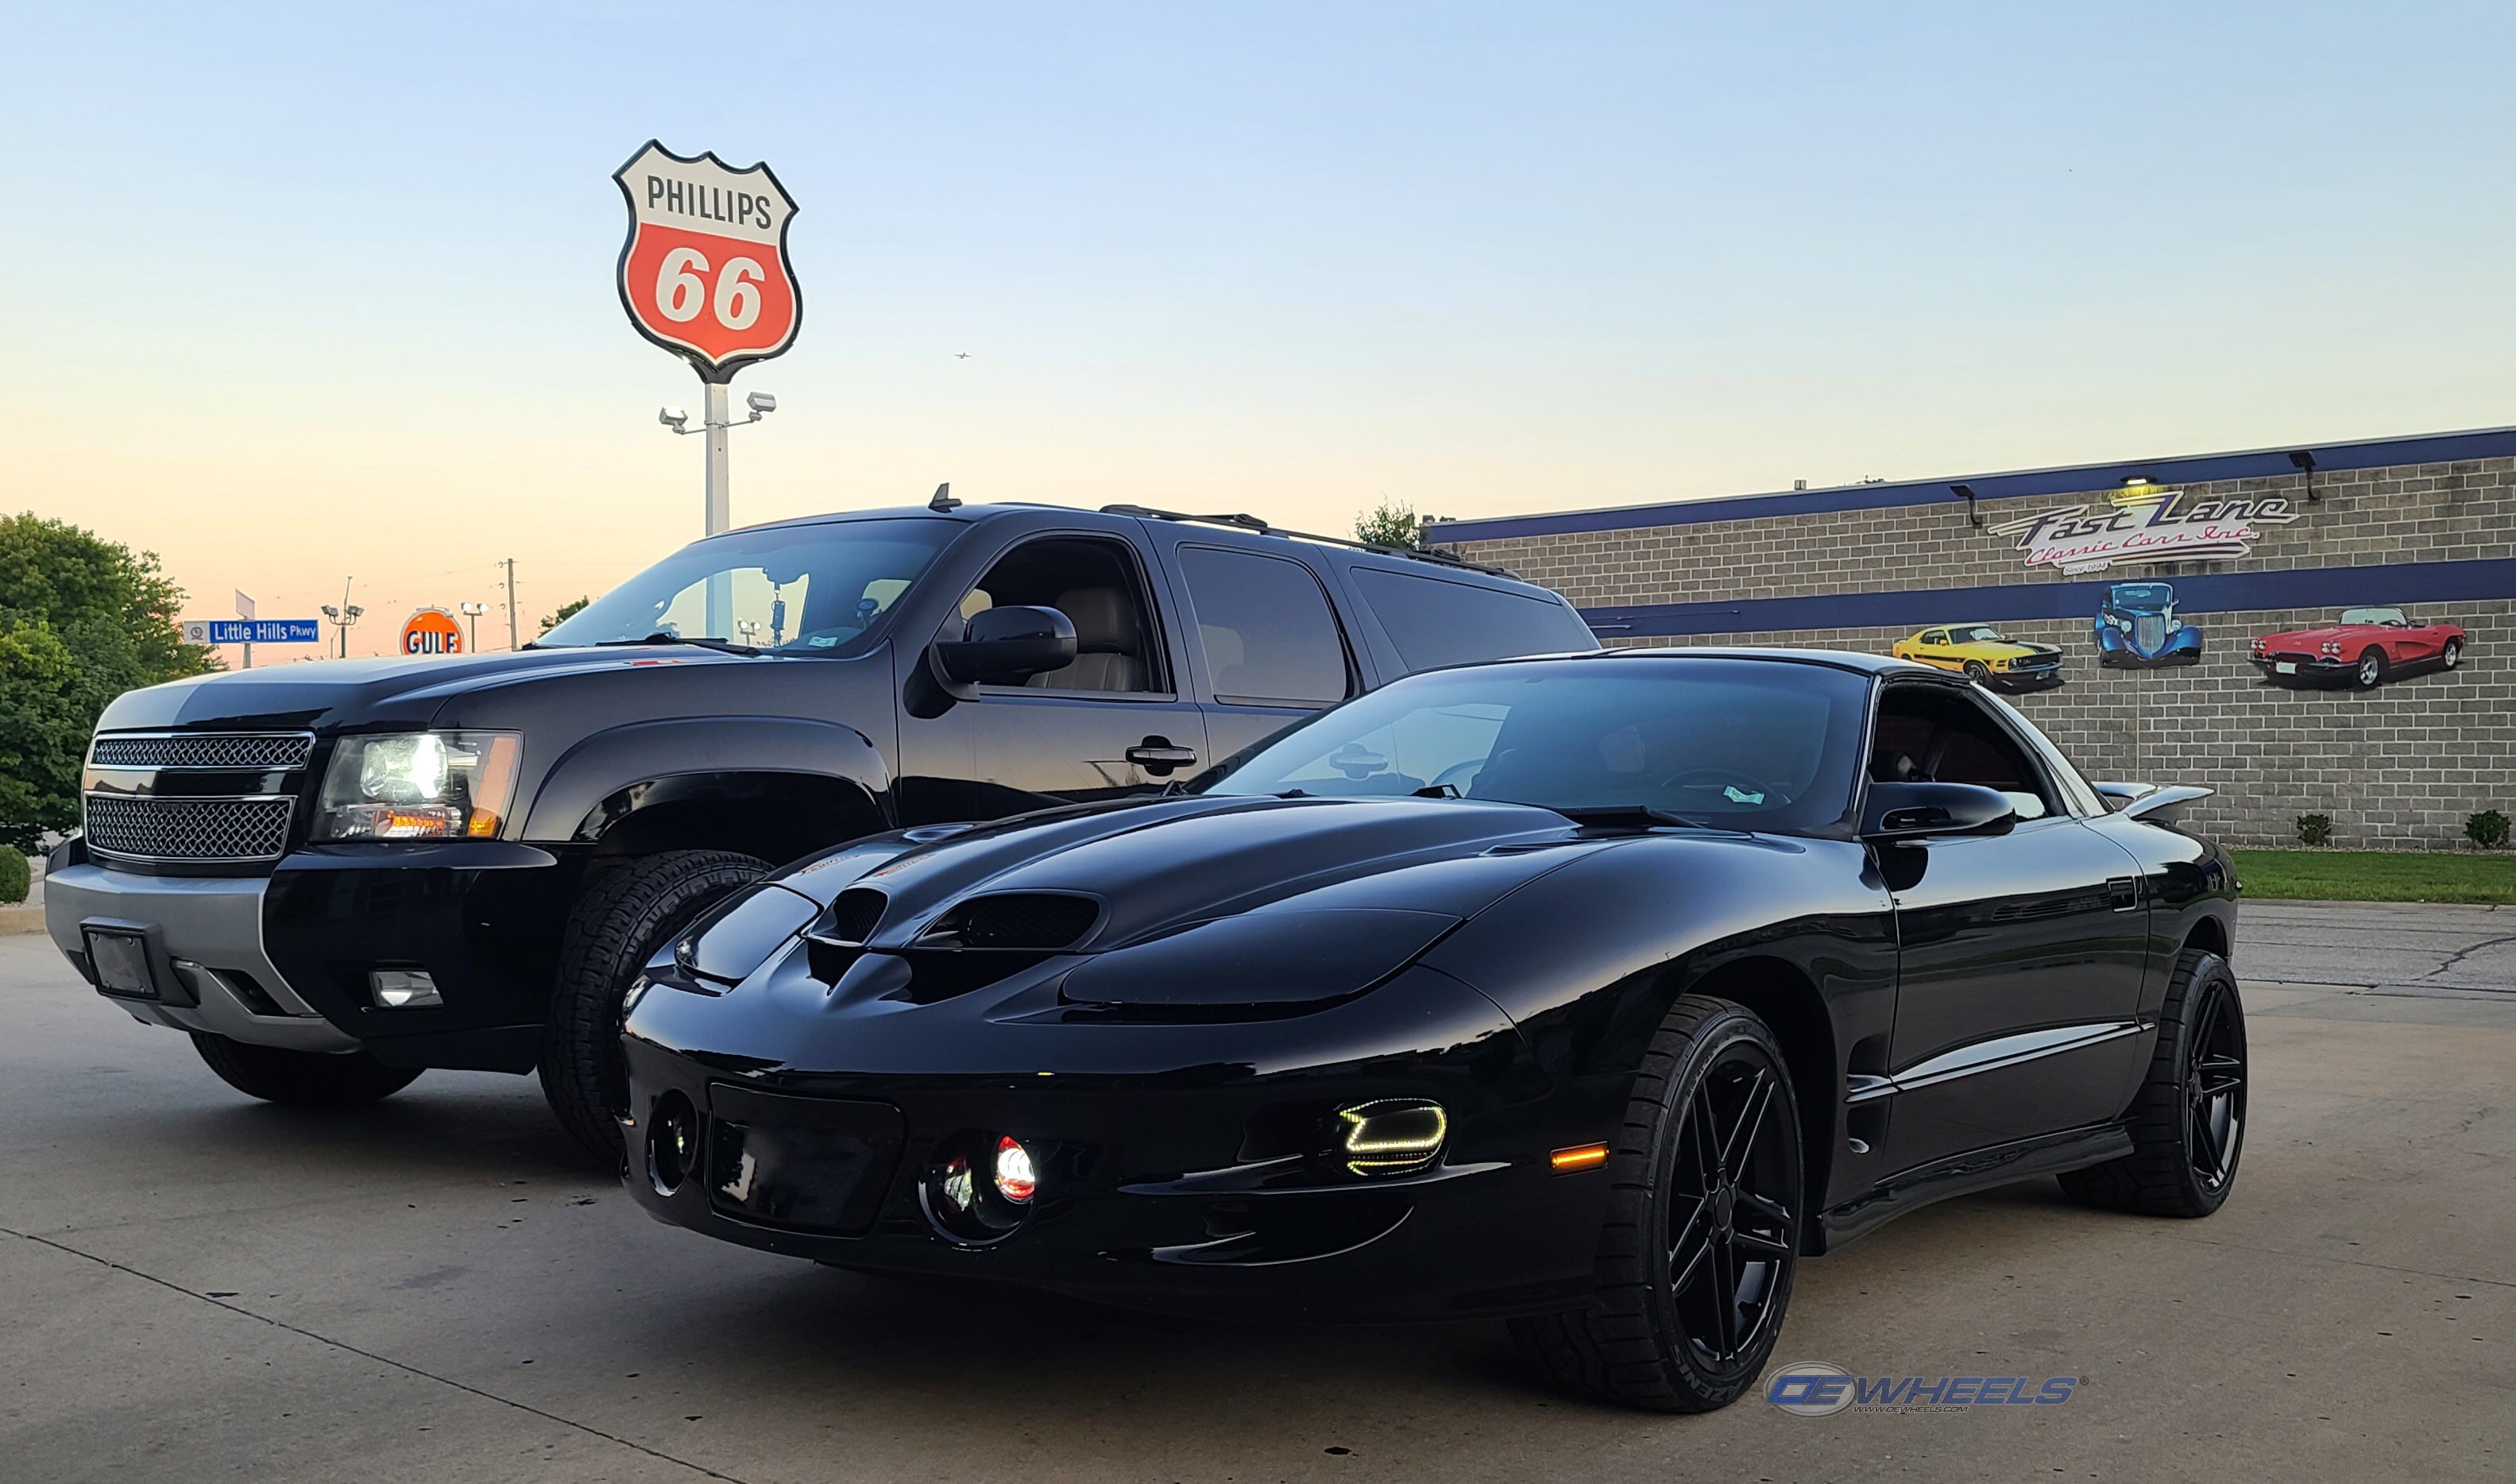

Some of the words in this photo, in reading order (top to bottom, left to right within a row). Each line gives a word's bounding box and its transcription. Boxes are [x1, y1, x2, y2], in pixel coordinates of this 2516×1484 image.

[647, 175, 771, 229] PHILLIPS
[655, 247, 765, 330] 66
[1988, 504, 2137, 551] Fast
[2110, 491, 2301, 528] Lane
[2026, 539, 2119, 565] Classic
[2122, 532, 2193, 548] Cars
[214, 623, 252, 640] Little
[257, 622, 288, 640] Hills
[290, 624, 316, 639] Pkwy
[407, 630, 458, 654] GULF
[1672, 1344, 1744, 1402] AZENIS
